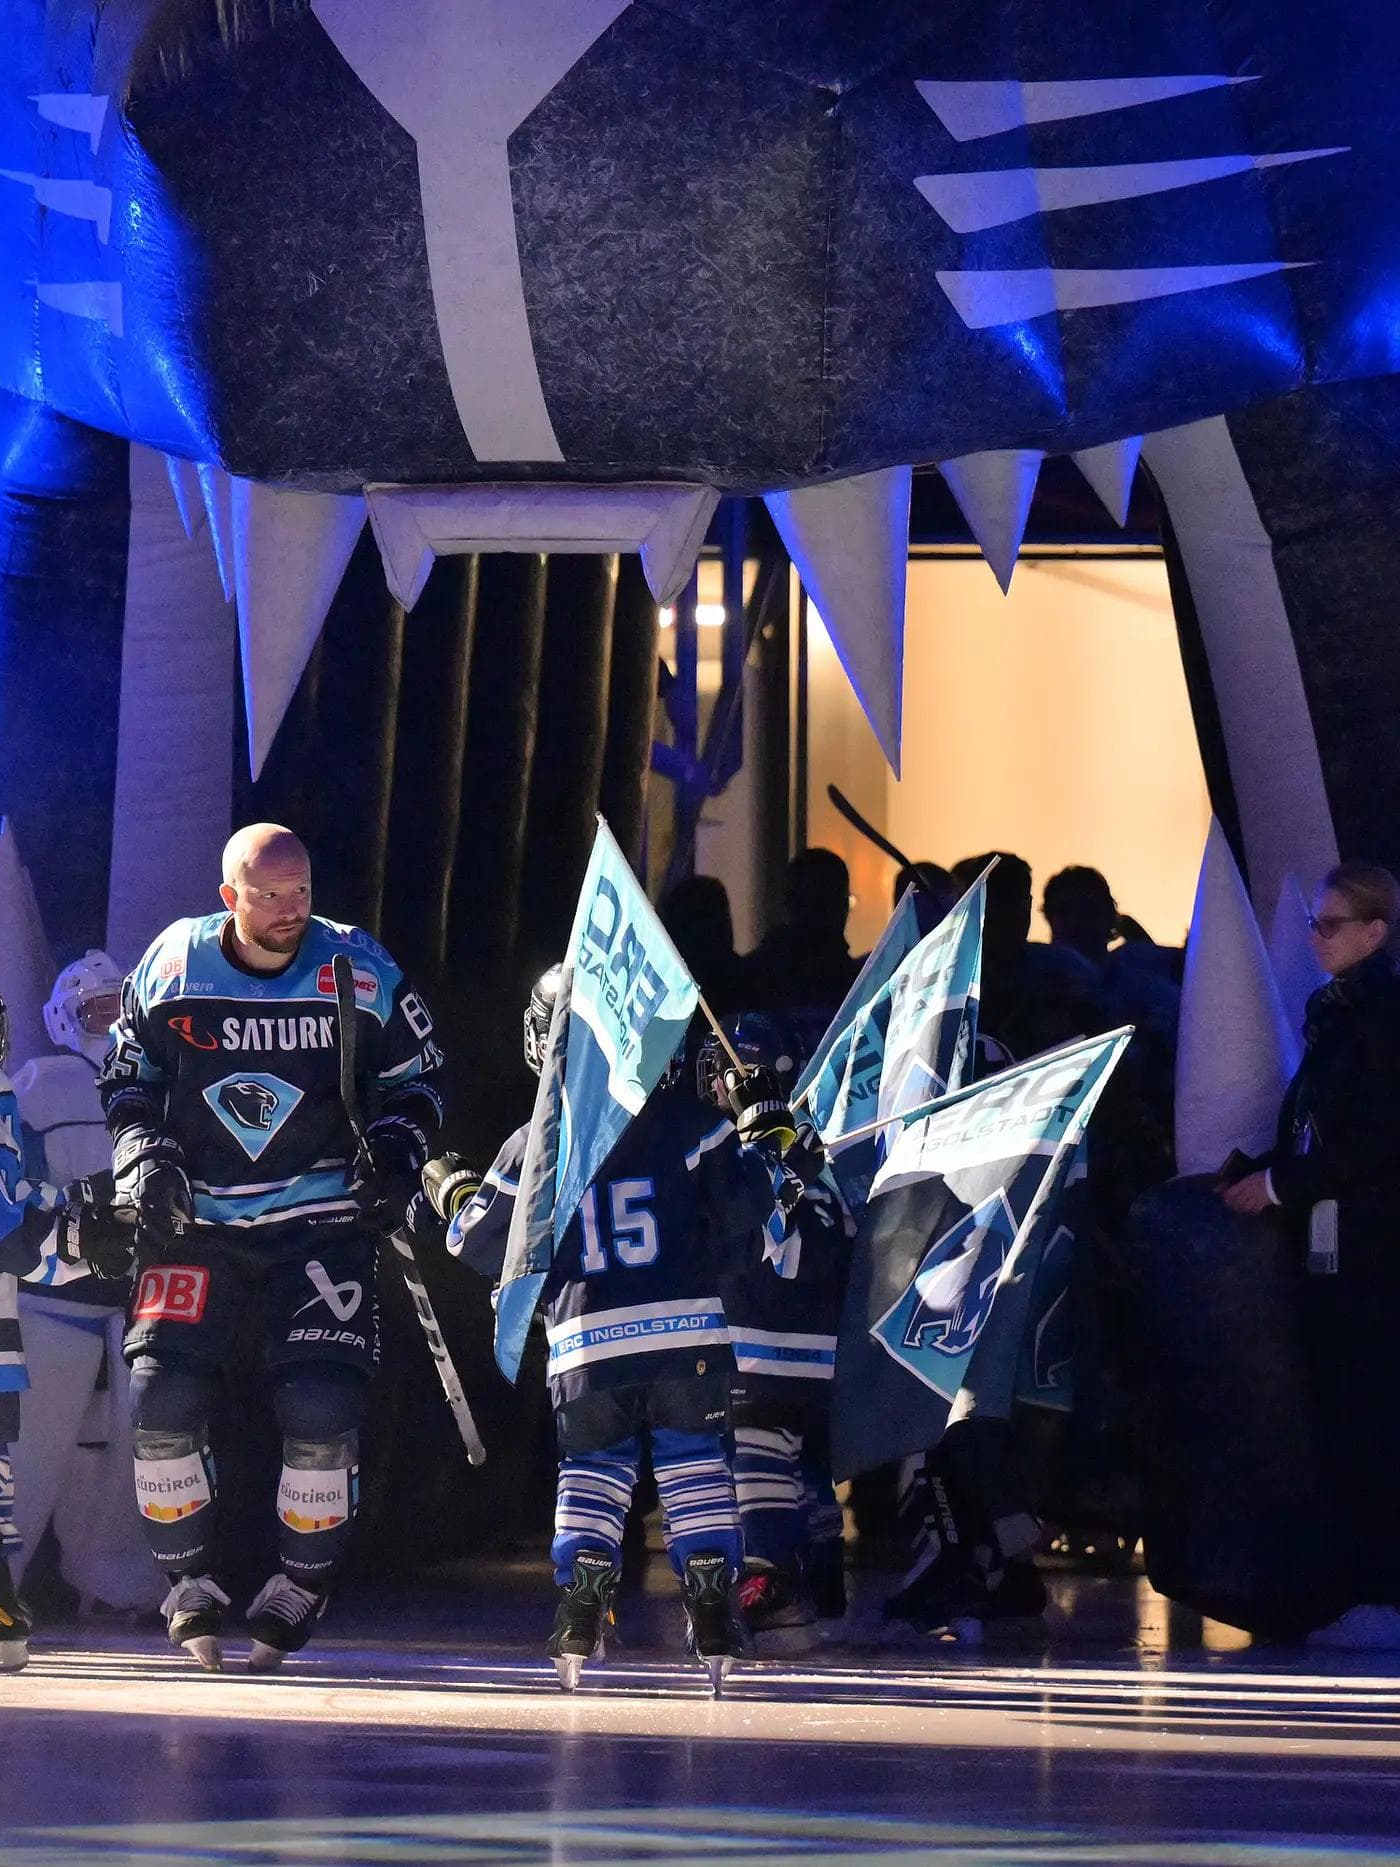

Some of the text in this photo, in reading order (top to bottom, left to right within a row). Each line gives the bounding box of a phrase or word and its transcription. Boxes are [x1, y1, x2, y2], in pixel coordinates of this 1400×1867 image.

[162, 958, 184, 977] DB
[222, 1015, 335, 1051] SATURN
[578, 1178, 661, 1275] 15
[135, 1271, 201, 1312] DB
[286, 1327, 367, 1350] BAUER
[557, 1315, 709, 1353] ERC INGOLSTADT
[576, 1555, 613, 1568] BAUER
[688, 1556, 725, 1567] BAUER
